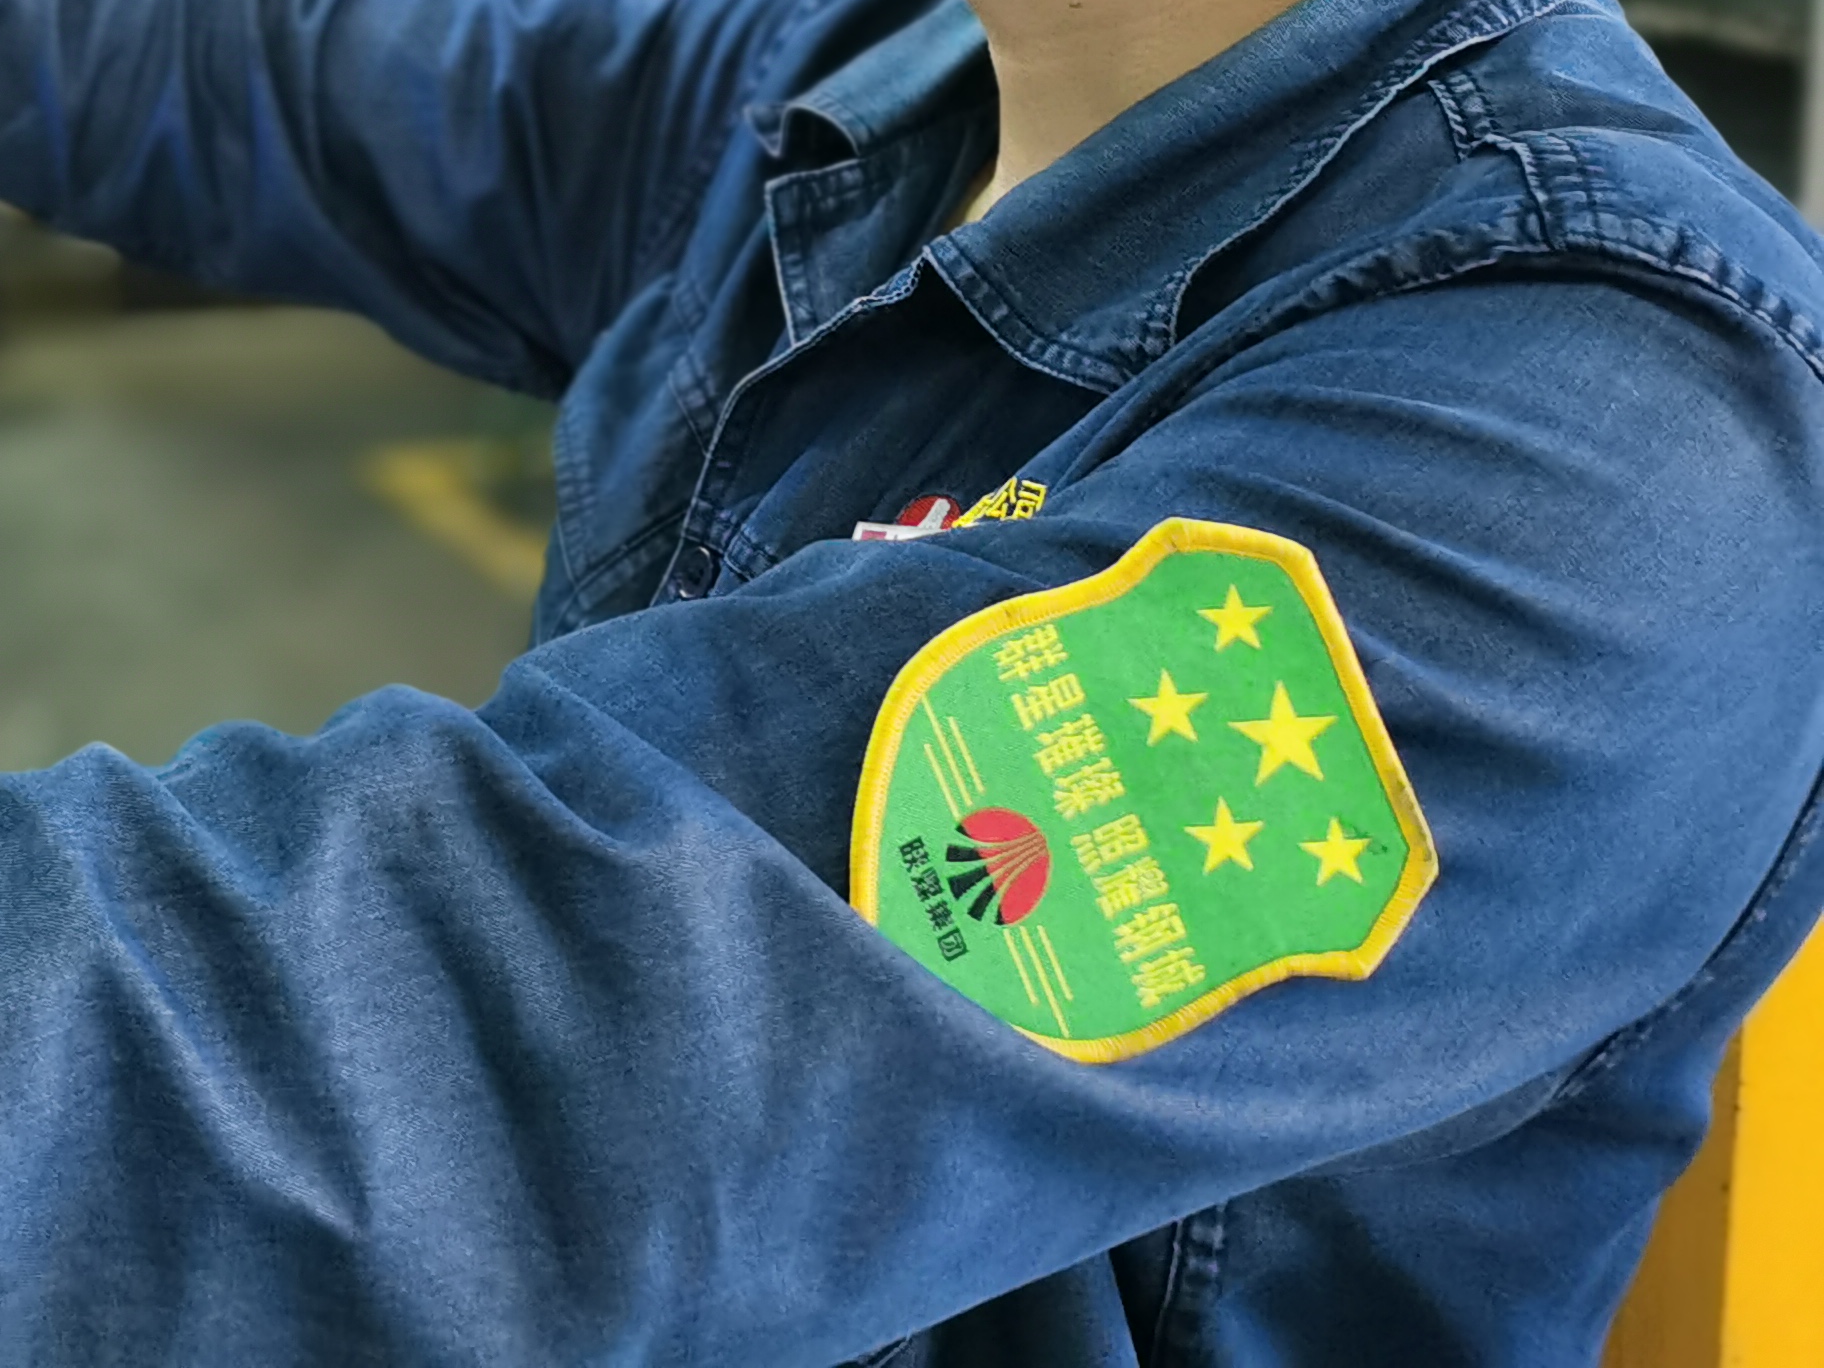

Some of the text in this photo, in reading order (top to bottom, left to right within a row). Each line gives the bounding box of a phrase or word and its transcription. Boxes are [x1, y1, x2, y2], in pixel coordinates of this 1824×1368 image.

[993, 624, 1207, 1008] 群星璀璨 照耀钢城
